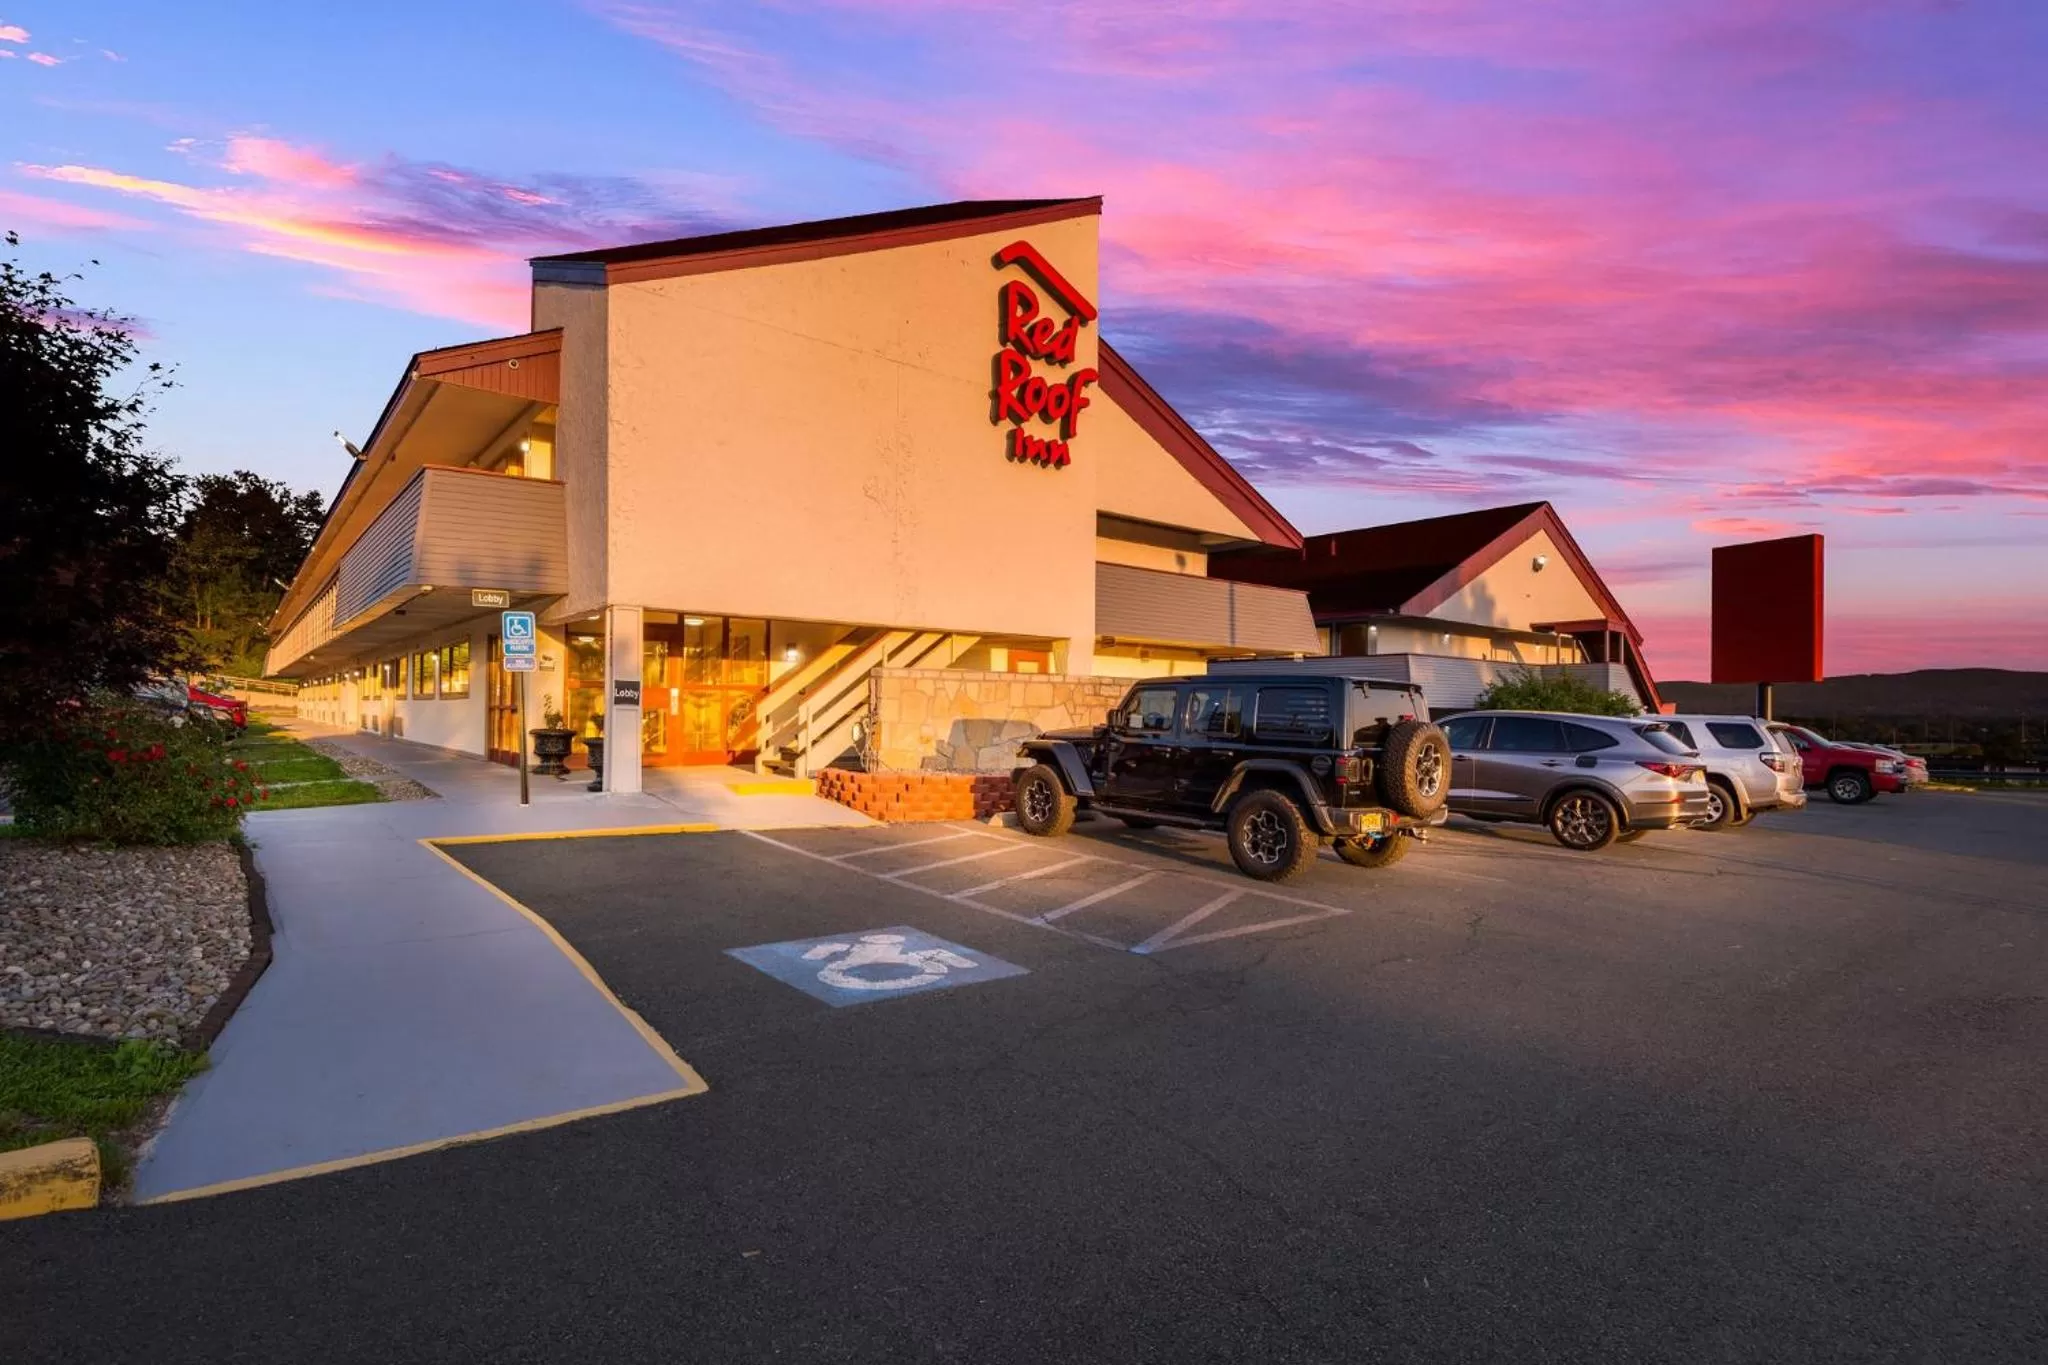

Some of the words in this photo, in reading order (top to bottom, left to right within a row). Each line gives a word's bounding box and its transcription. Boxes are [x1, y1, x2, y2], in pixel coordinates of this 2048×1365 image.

[1003, 280, 1079, 364] Red
[994, 348, 1100, 440] Roof
[1010, 426, 1071, 467] Inn
[478, 593, 503, 605] Lobby
[614, 687, 640, 700] Lobby
